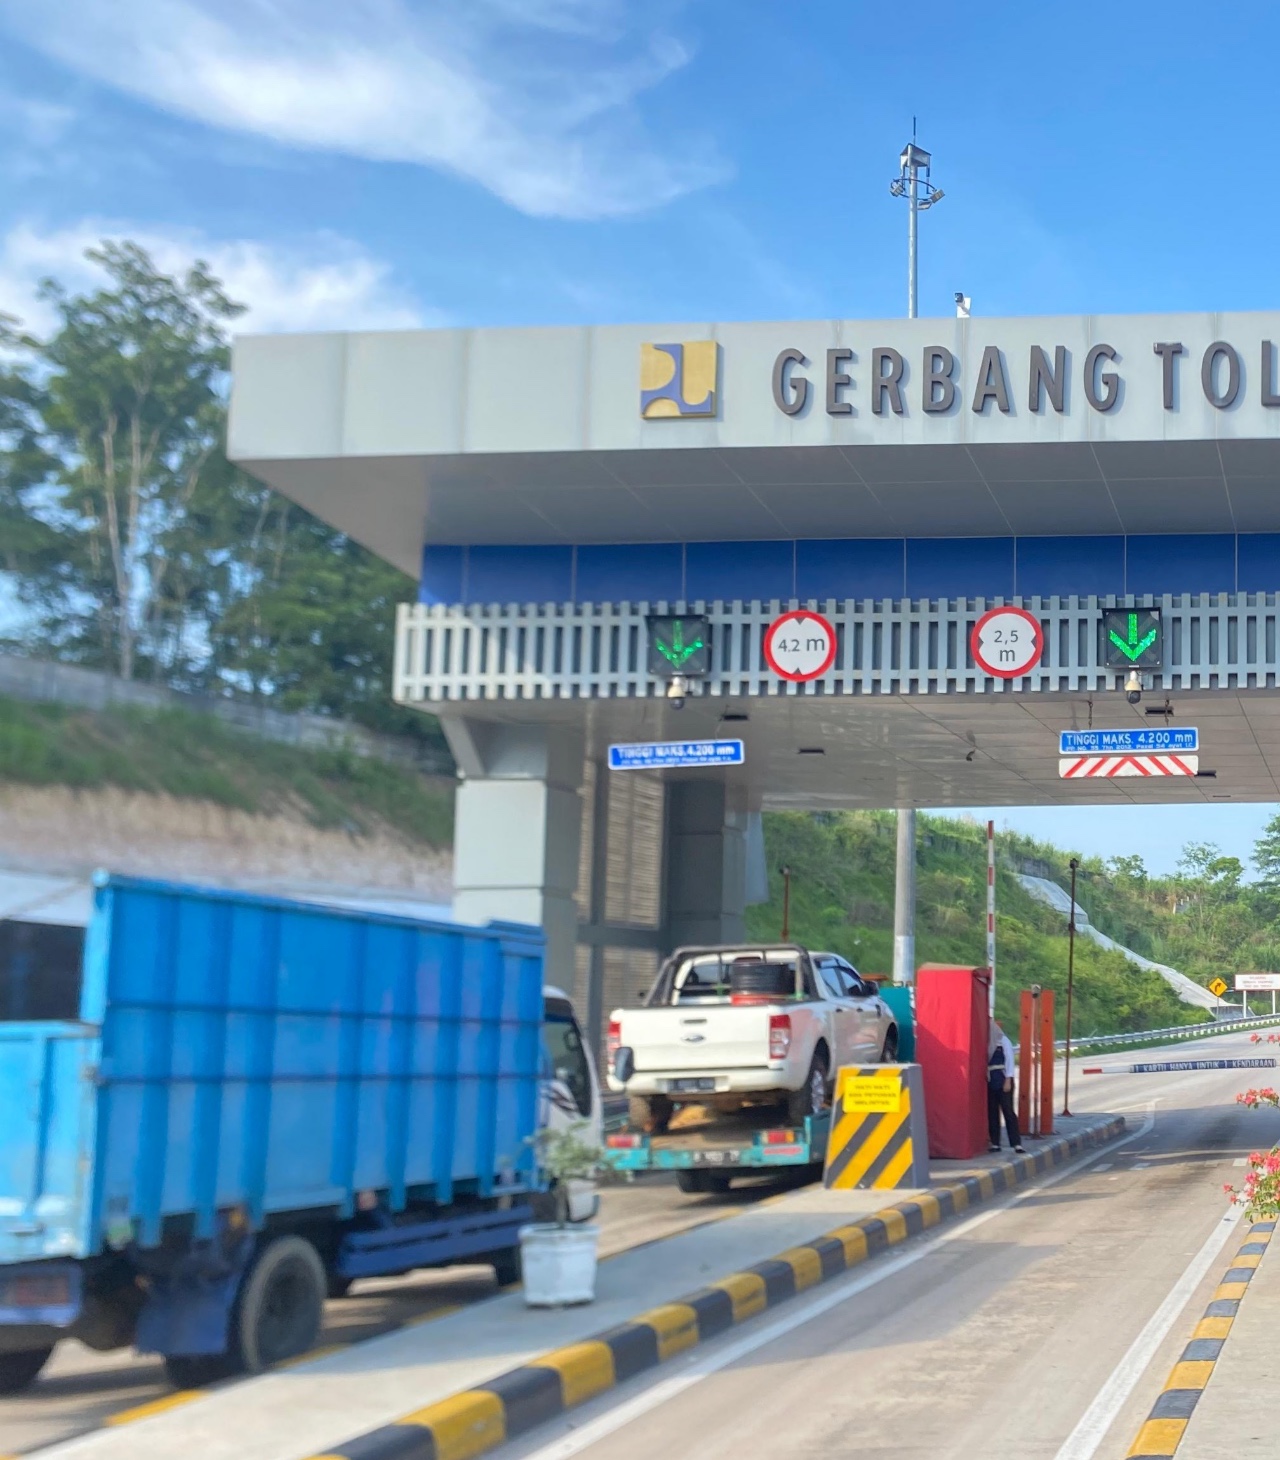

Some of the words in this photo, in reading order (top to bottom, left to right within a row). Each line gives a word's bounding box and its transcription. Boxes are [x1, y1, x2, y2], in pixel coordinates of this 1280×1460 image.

[772, 344, 1124, 414] GERBANG
[805, 637, 826, 652] m
[993, 630, 1019, 645] 2,5
[999, 649, 1016, 663] m
[1066, 734, 1099, 745] TINGGI
[1102, 733, 1134, 745] MAKS.
[1137, 732, 1170, 744] 4.200
[1174, 733, 1193, 743] mm
[617, 747, 653, 759] TINGGI
[716, 745, 735, 755] mm
[1143, 1064, 1167, 1072] KARTU
[1170, 1062, 1193, 1071] HANYA
[1197, 1061, 1220, 1070] UNTUK
[1232, 1059, 1273, 1068] KENDARAAN
